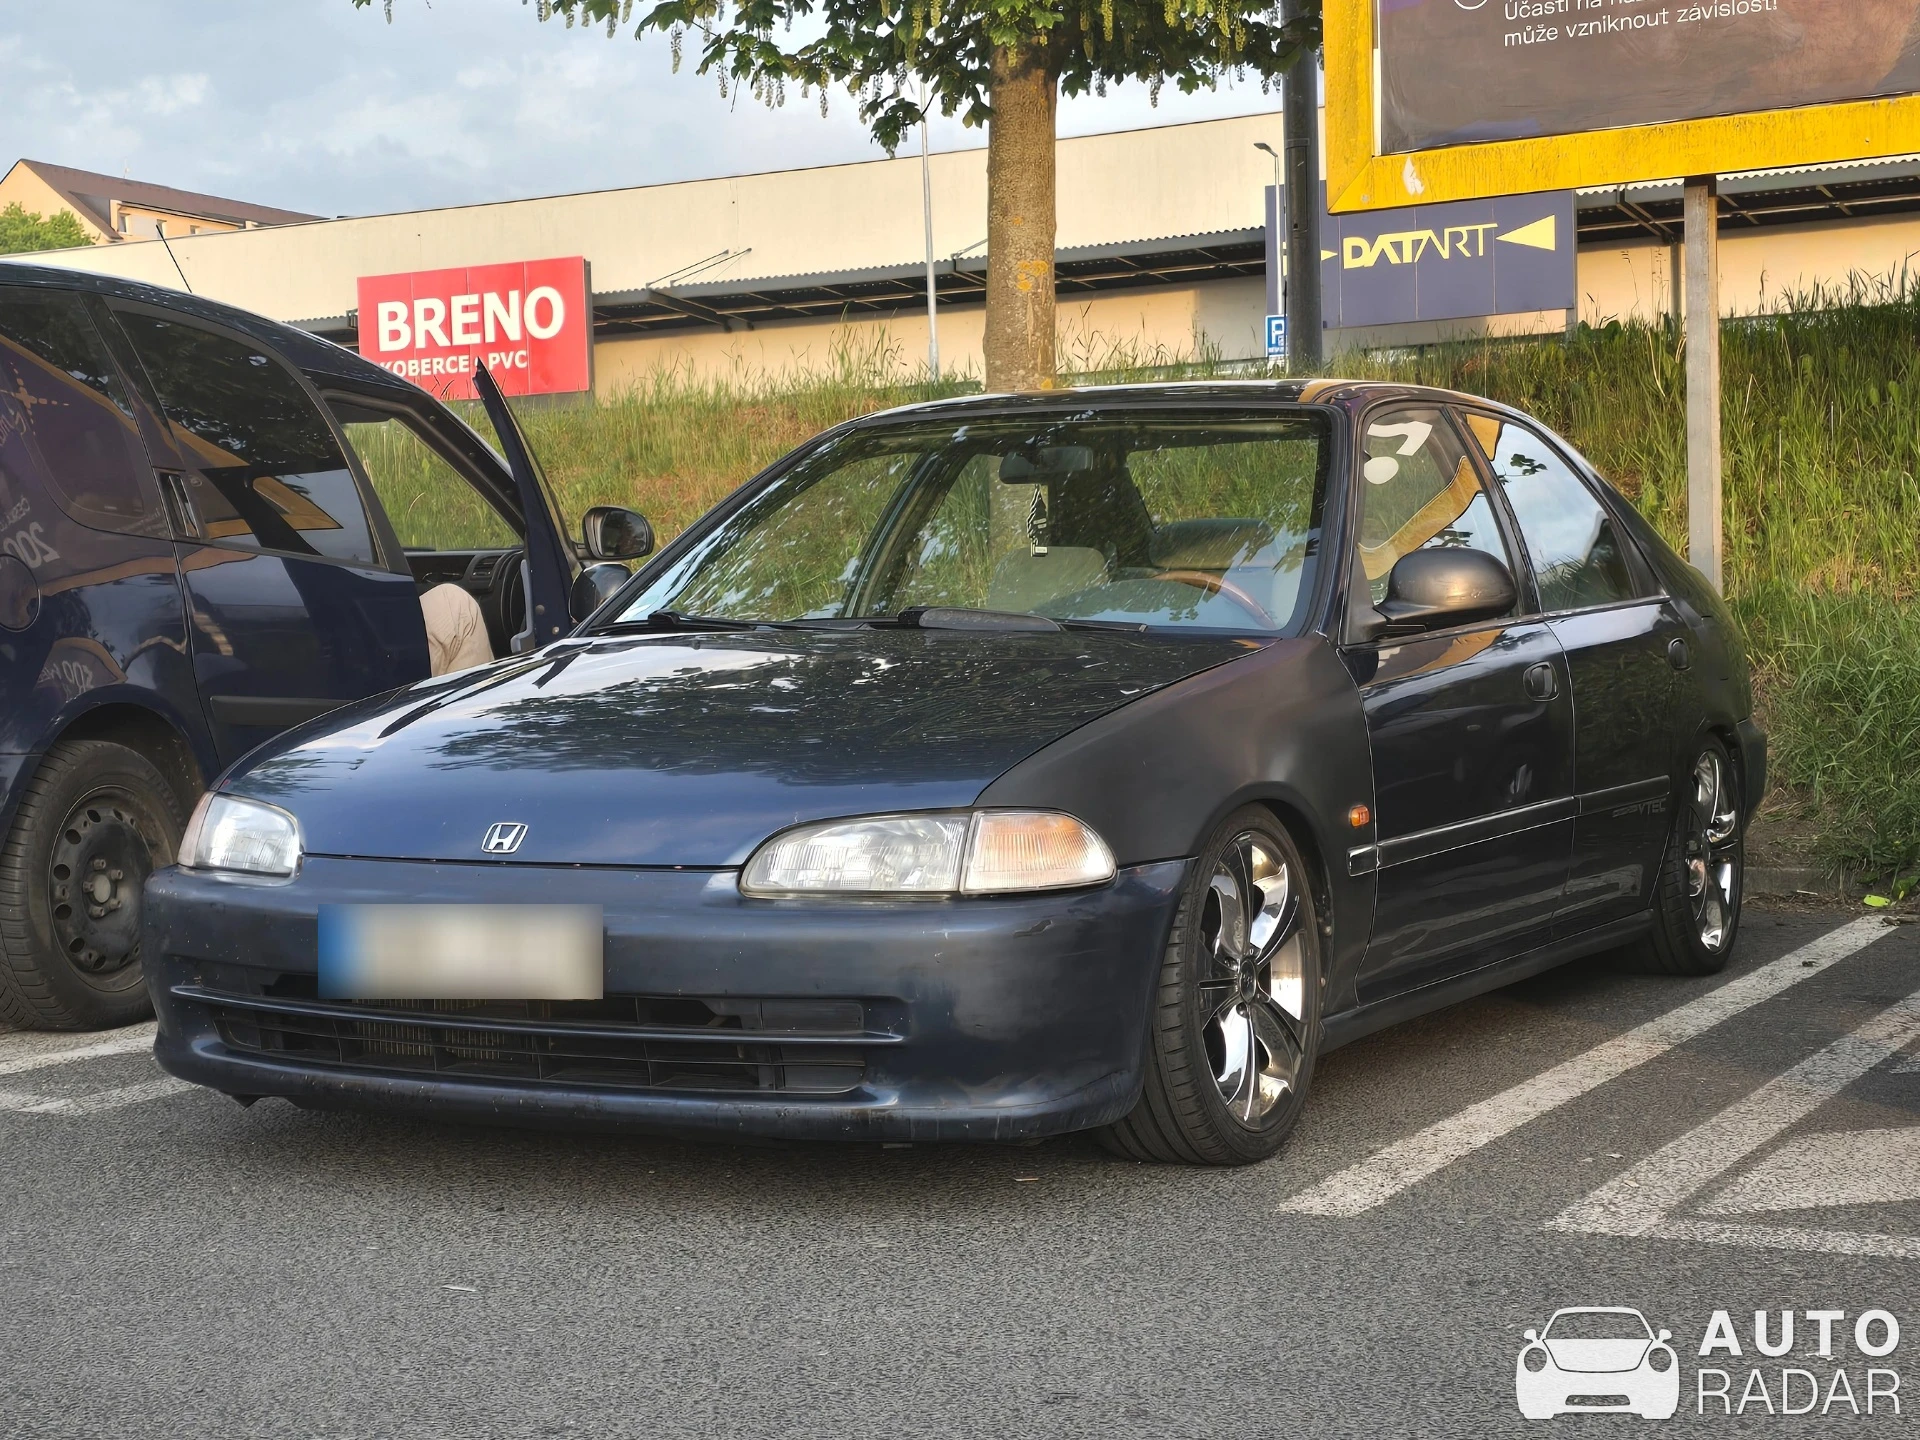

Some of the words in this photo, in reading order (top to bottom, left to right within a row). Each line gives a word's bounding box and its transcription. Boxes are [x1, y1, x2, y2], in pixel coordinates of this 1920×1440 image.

[1504, 24, 1558, 47] může
[1566, 8, 1669, 38] vzniknout
[1677, 0, 1778, 23] závislost!
[1343, 223, 1498, 269] DATART
[377, 286, 565, 352] BRENO
[488, 350, 528, 371] PVC
[1638, 798, 1667, 815] VTEC
